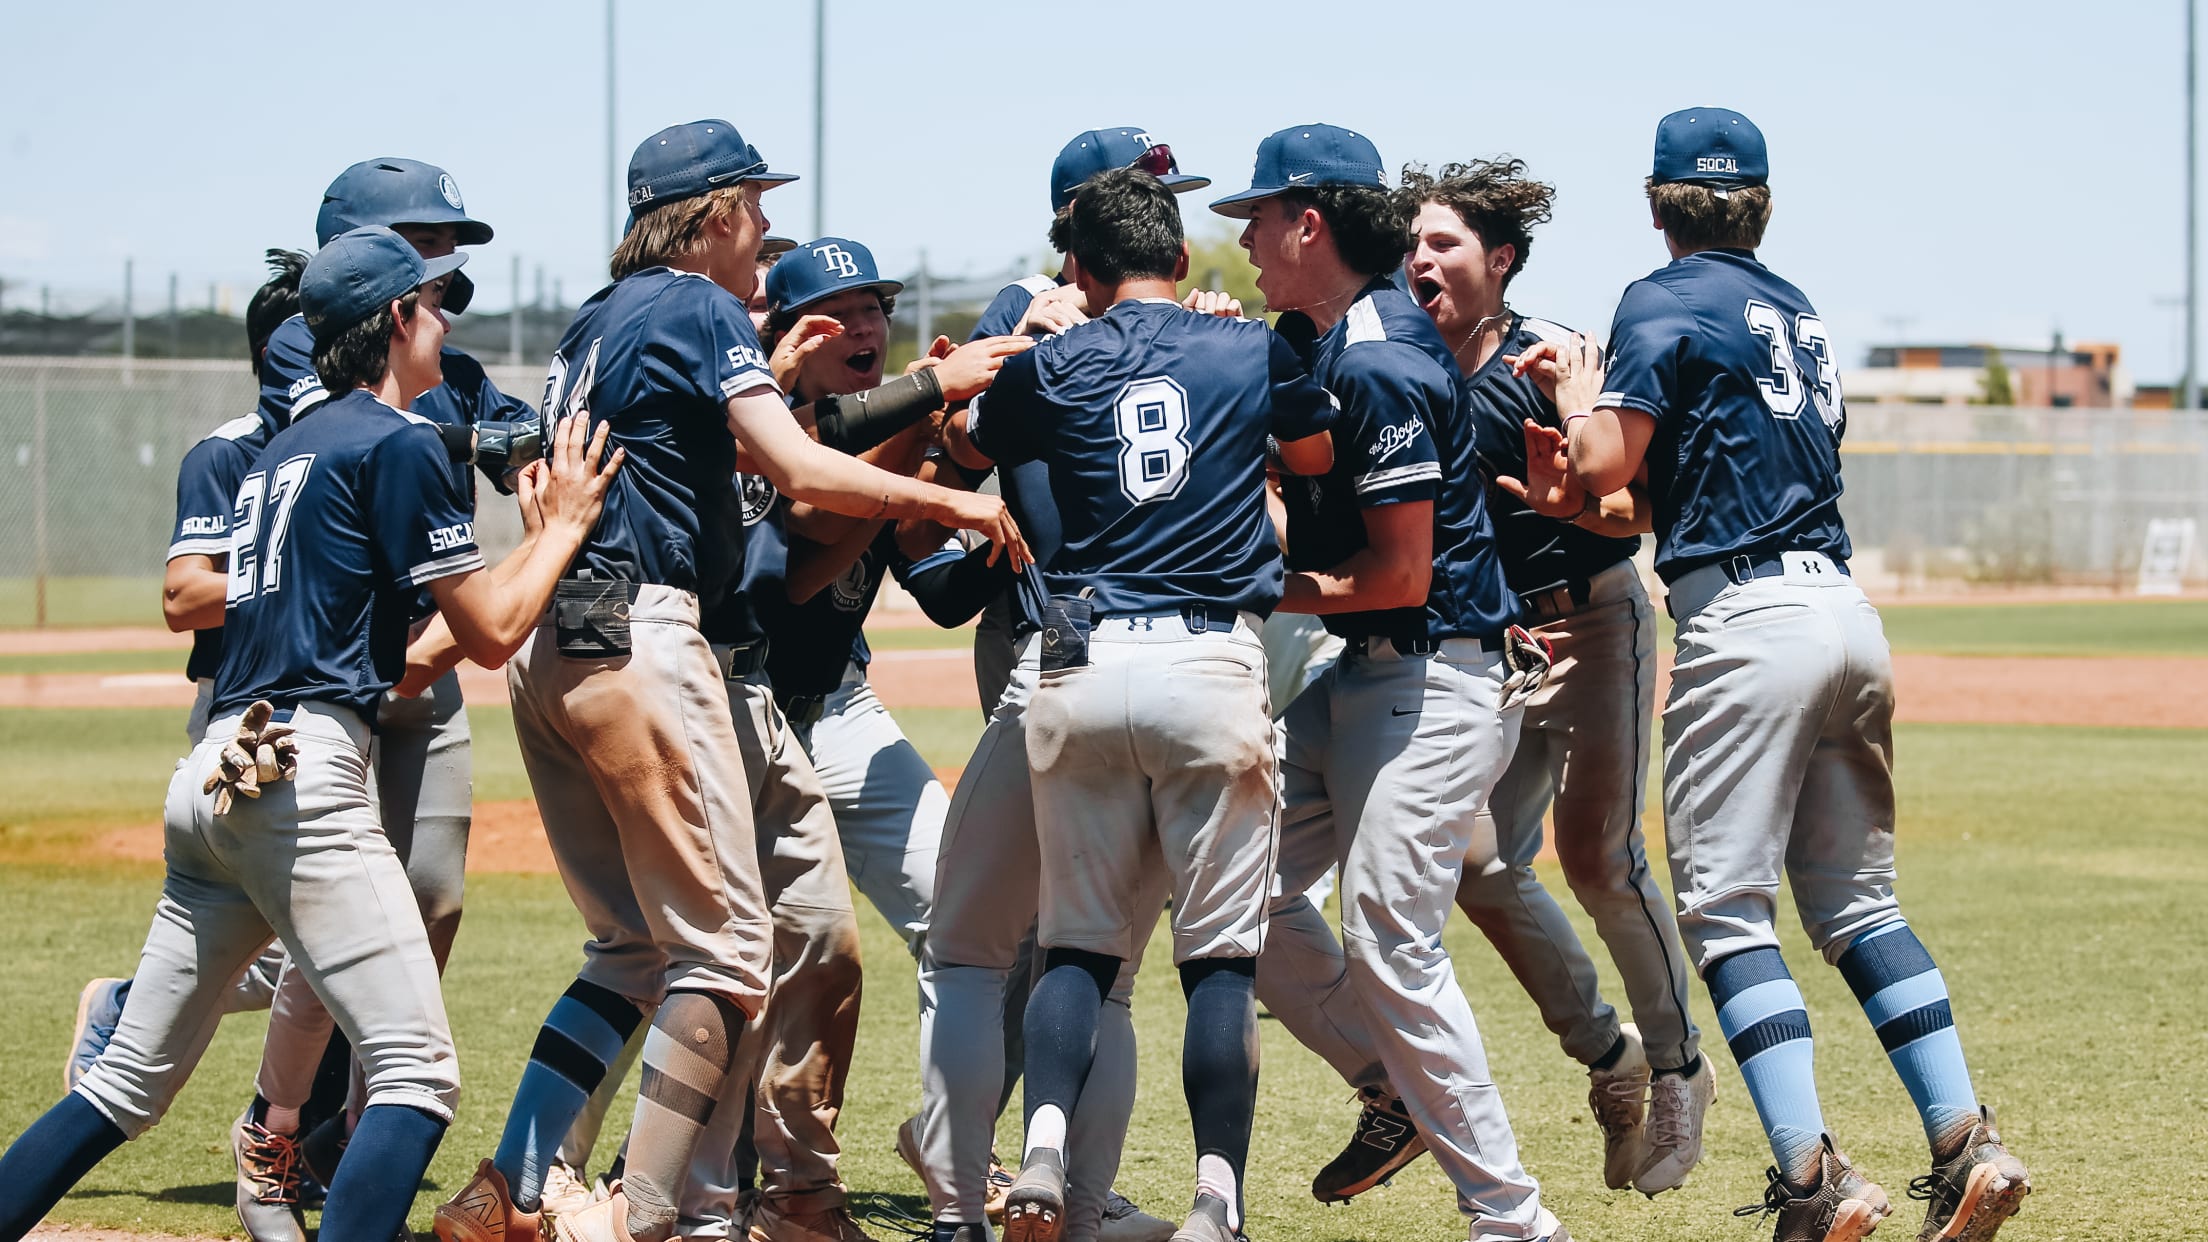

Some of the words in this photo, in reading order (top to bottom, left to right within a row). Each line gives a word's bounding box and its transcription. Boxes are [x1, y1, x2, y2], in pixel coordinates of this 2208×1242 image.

[1696, 157, 1739, 173] SOCAL
[813, 243, 858, 279] TB
[1743, 298, 1843, 434] 33
[1112, 374, 1192, 506] 8
[1378, 414, 1424, 464] Boys
[181, 514, 229, 537] SOCAL
[225, 453, 317, 609] 27
